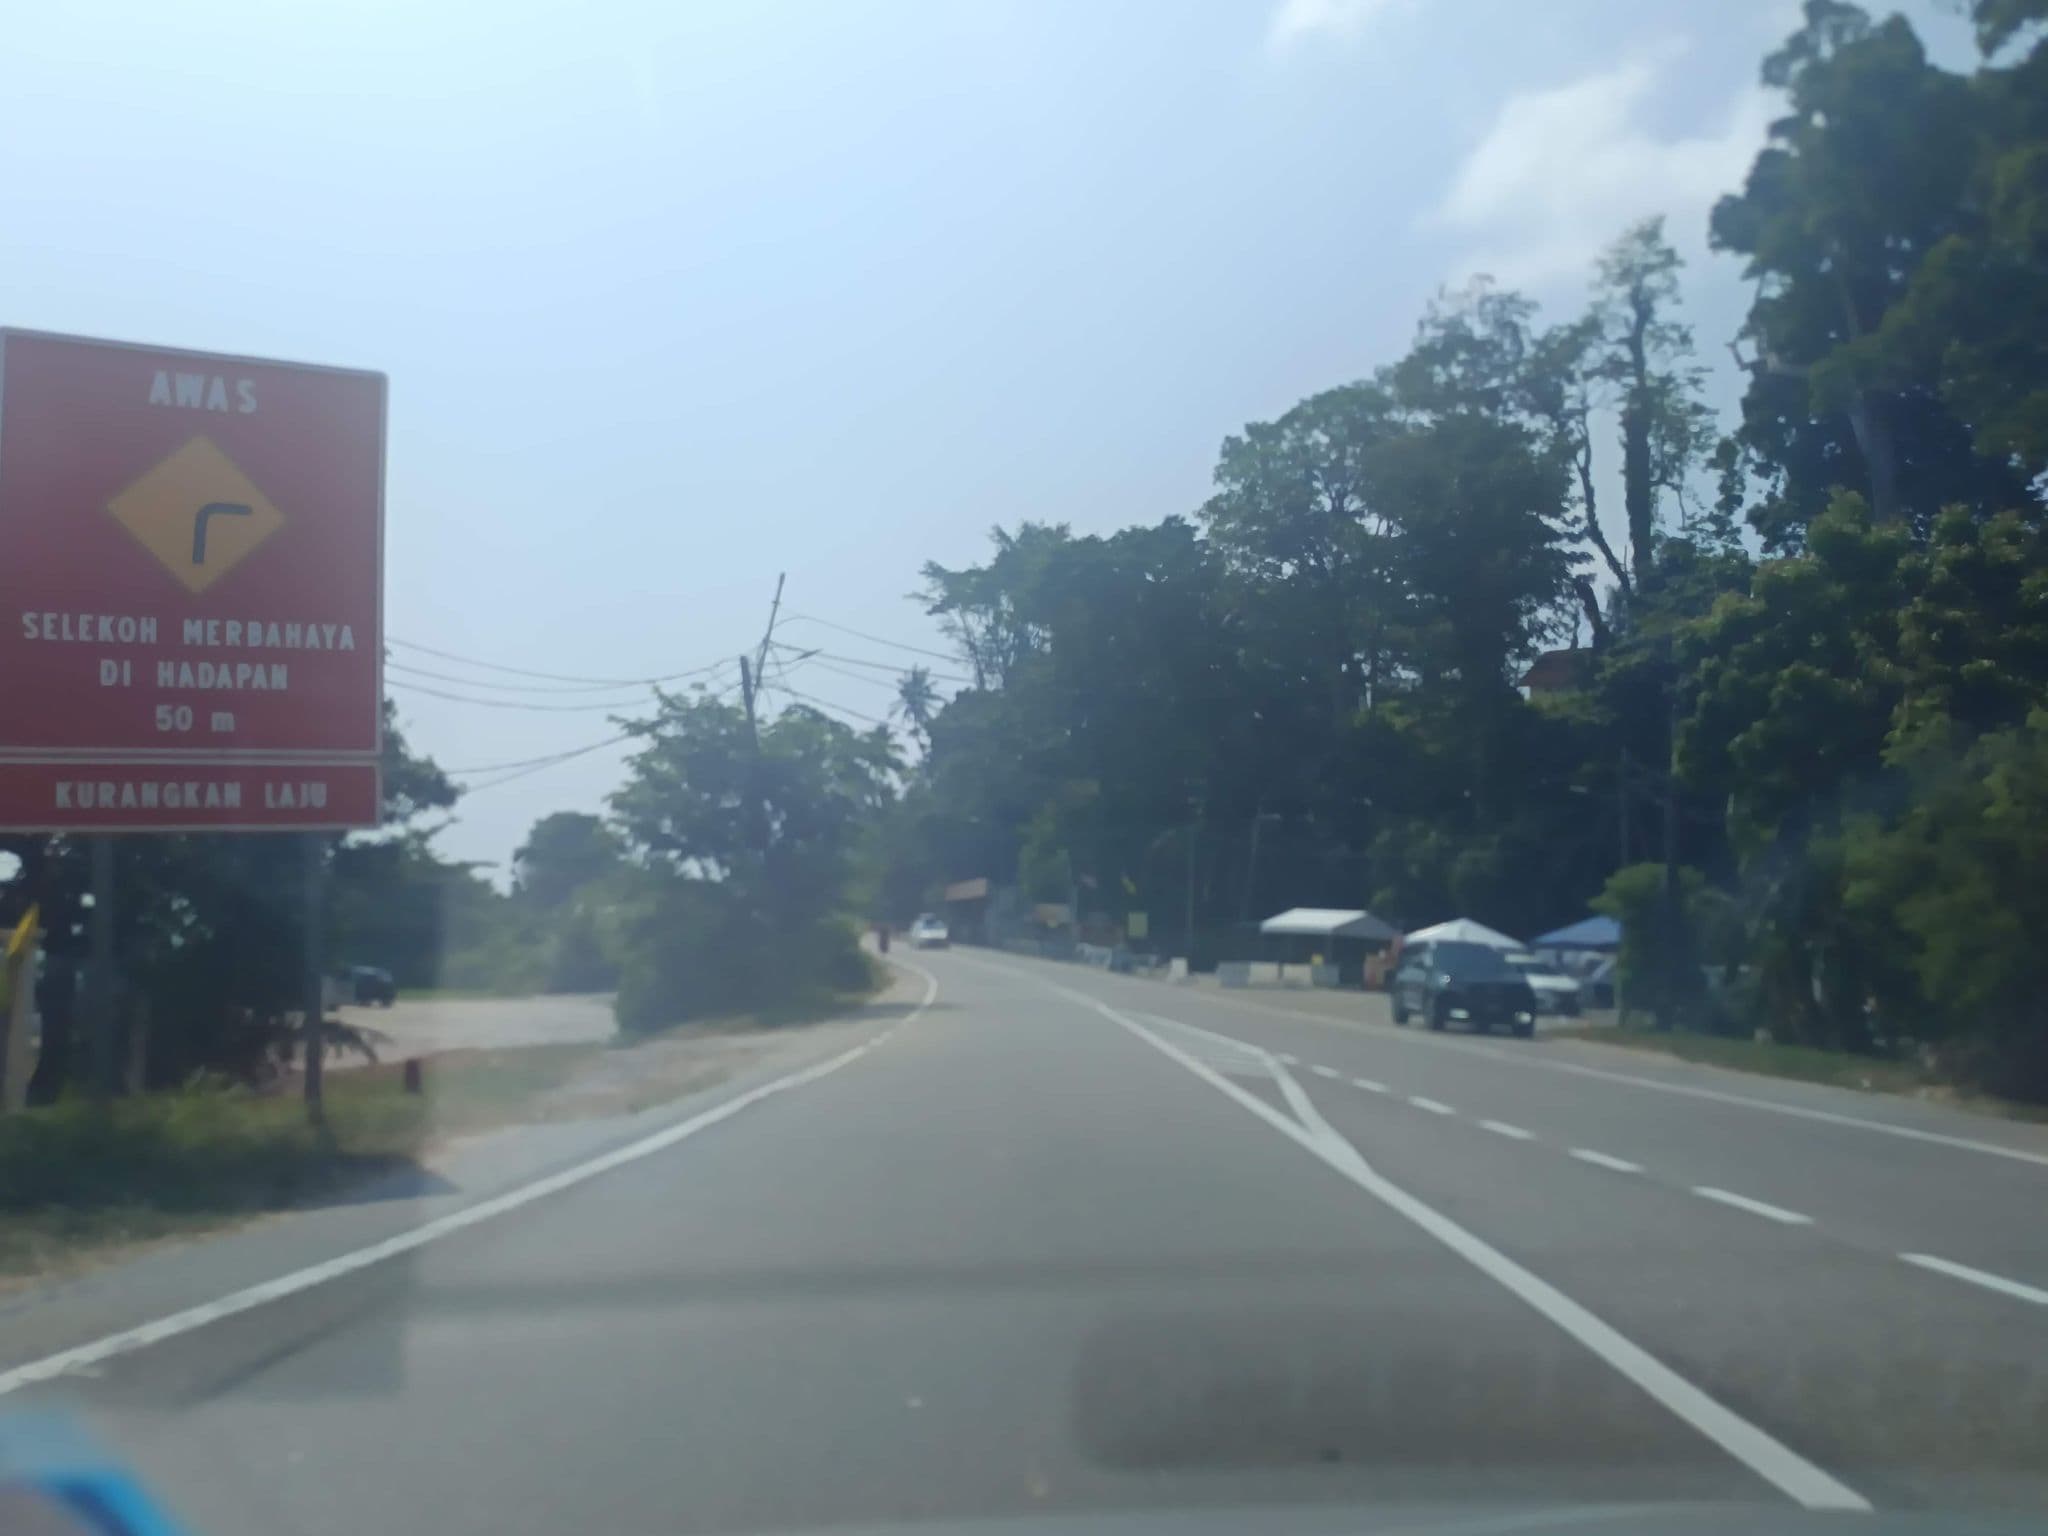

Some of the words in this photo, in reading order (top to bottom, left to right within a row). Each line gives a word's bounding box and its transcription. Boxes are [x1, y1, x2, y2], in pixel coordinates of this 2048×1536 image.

[150, 370, 258, 414] AWAS
[22, 612, 157, 644] SELEKOH
[183, 618, 355, 651] MERBAHAYA
[100, 660, 131, 687] DI
[157, 662, 288, 690] HADAPAN
[156, 705, 193, 732] 50
[211, 711, 235, 732] m
[56, 782, 241, 808] KURANGKAN
[265, 782, 327, 808] LAJU
